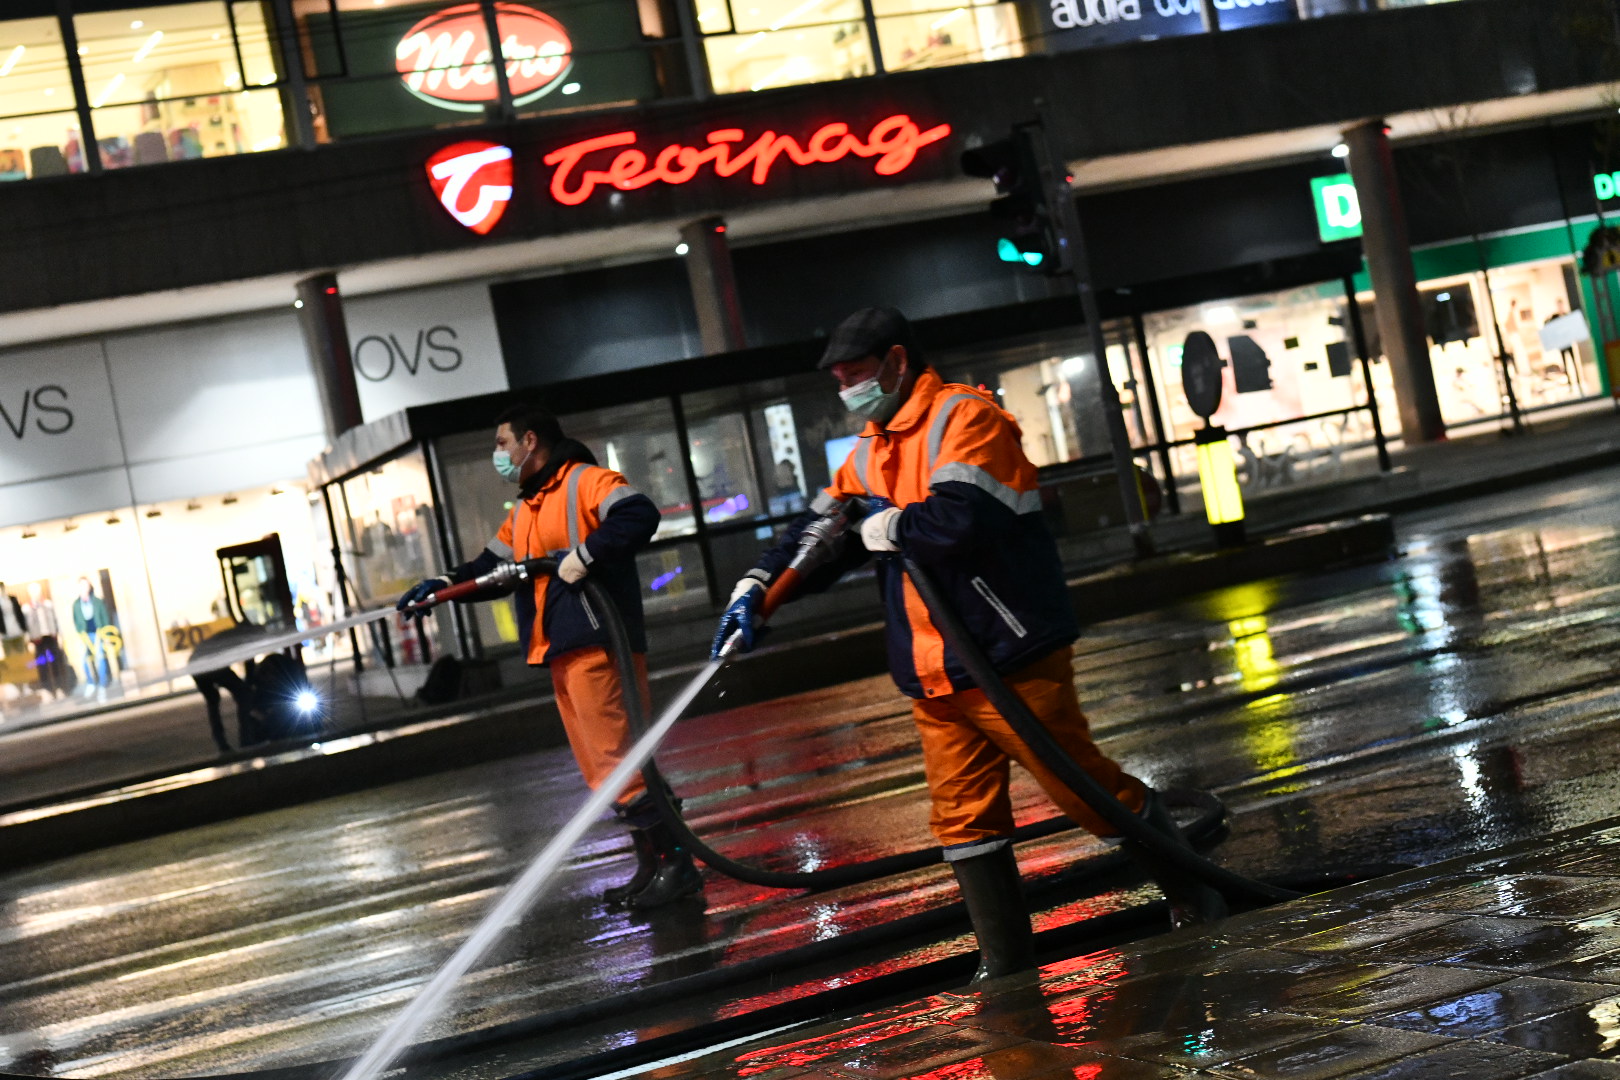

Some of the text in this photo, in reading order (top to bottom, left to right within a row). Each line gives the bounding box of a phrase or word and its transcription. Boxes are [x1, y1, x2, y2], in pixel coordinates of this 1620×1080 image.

[354, 325, 462, 382] OVS
[0, 385, 74, 439] VS
[171, 624, 210, 651] 20
